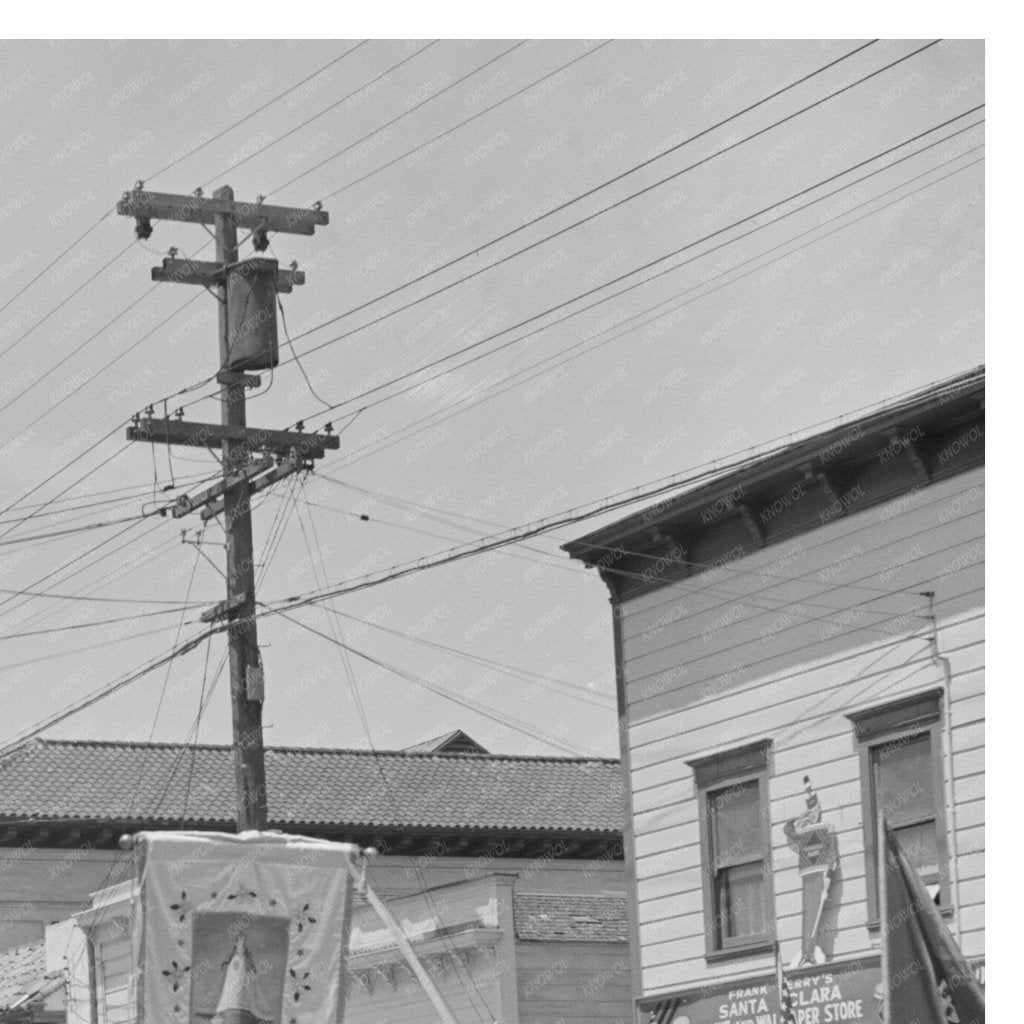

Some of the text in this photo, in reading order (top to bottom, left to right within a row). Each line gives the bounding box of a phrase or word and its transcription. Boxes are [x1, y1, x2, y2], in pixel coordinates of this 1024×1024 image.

[728, 973, 833, 1000] FRANK ERRY'S
[719, 985, 842, 1019] SANTA CLARA
[824, 999, 863, 1023] STORE
